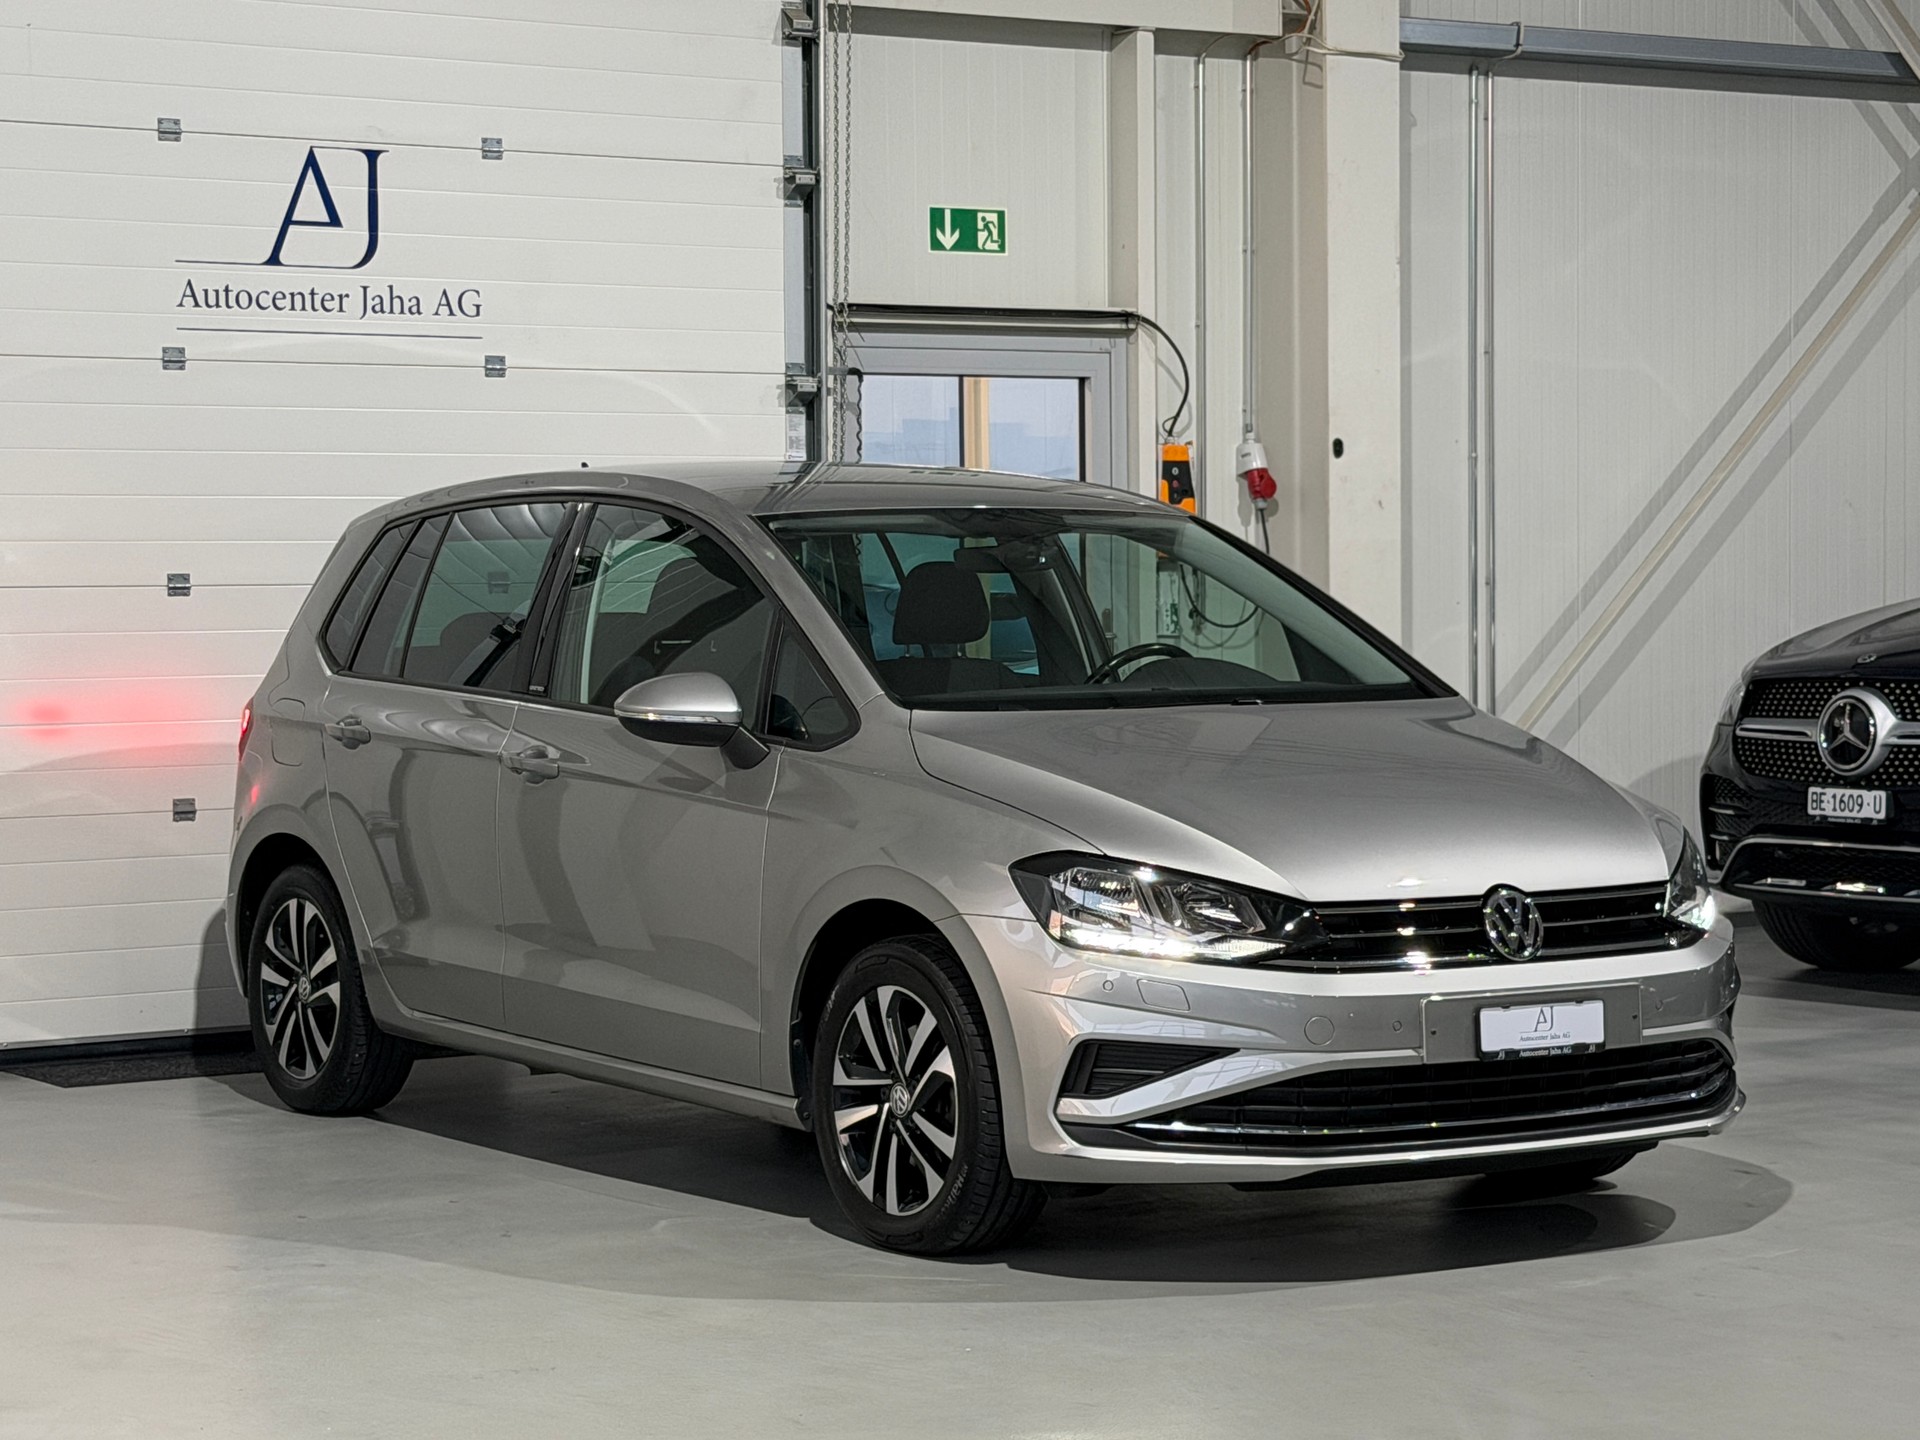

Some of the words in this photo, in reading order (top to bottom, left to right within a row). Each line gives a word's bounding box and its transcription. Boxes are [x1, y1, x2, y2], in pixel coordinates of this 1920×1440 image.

[261, 146, 389, 269] AJ
[176, 278, 350, 313] Autocenter
[359, 284, 423, 320] Jaha
[432, 288, 483, 318] AG
[1811, 791, 1826, 811] BE
[1831, 792, 1864, 814] 1609
[1873, 794, 1882, 815] U
[1534, 1006, 1554, 1032] AJ
[1562, 1031, 1571, 1039] AG
[1562, 1045, 1572, 1054] AG
